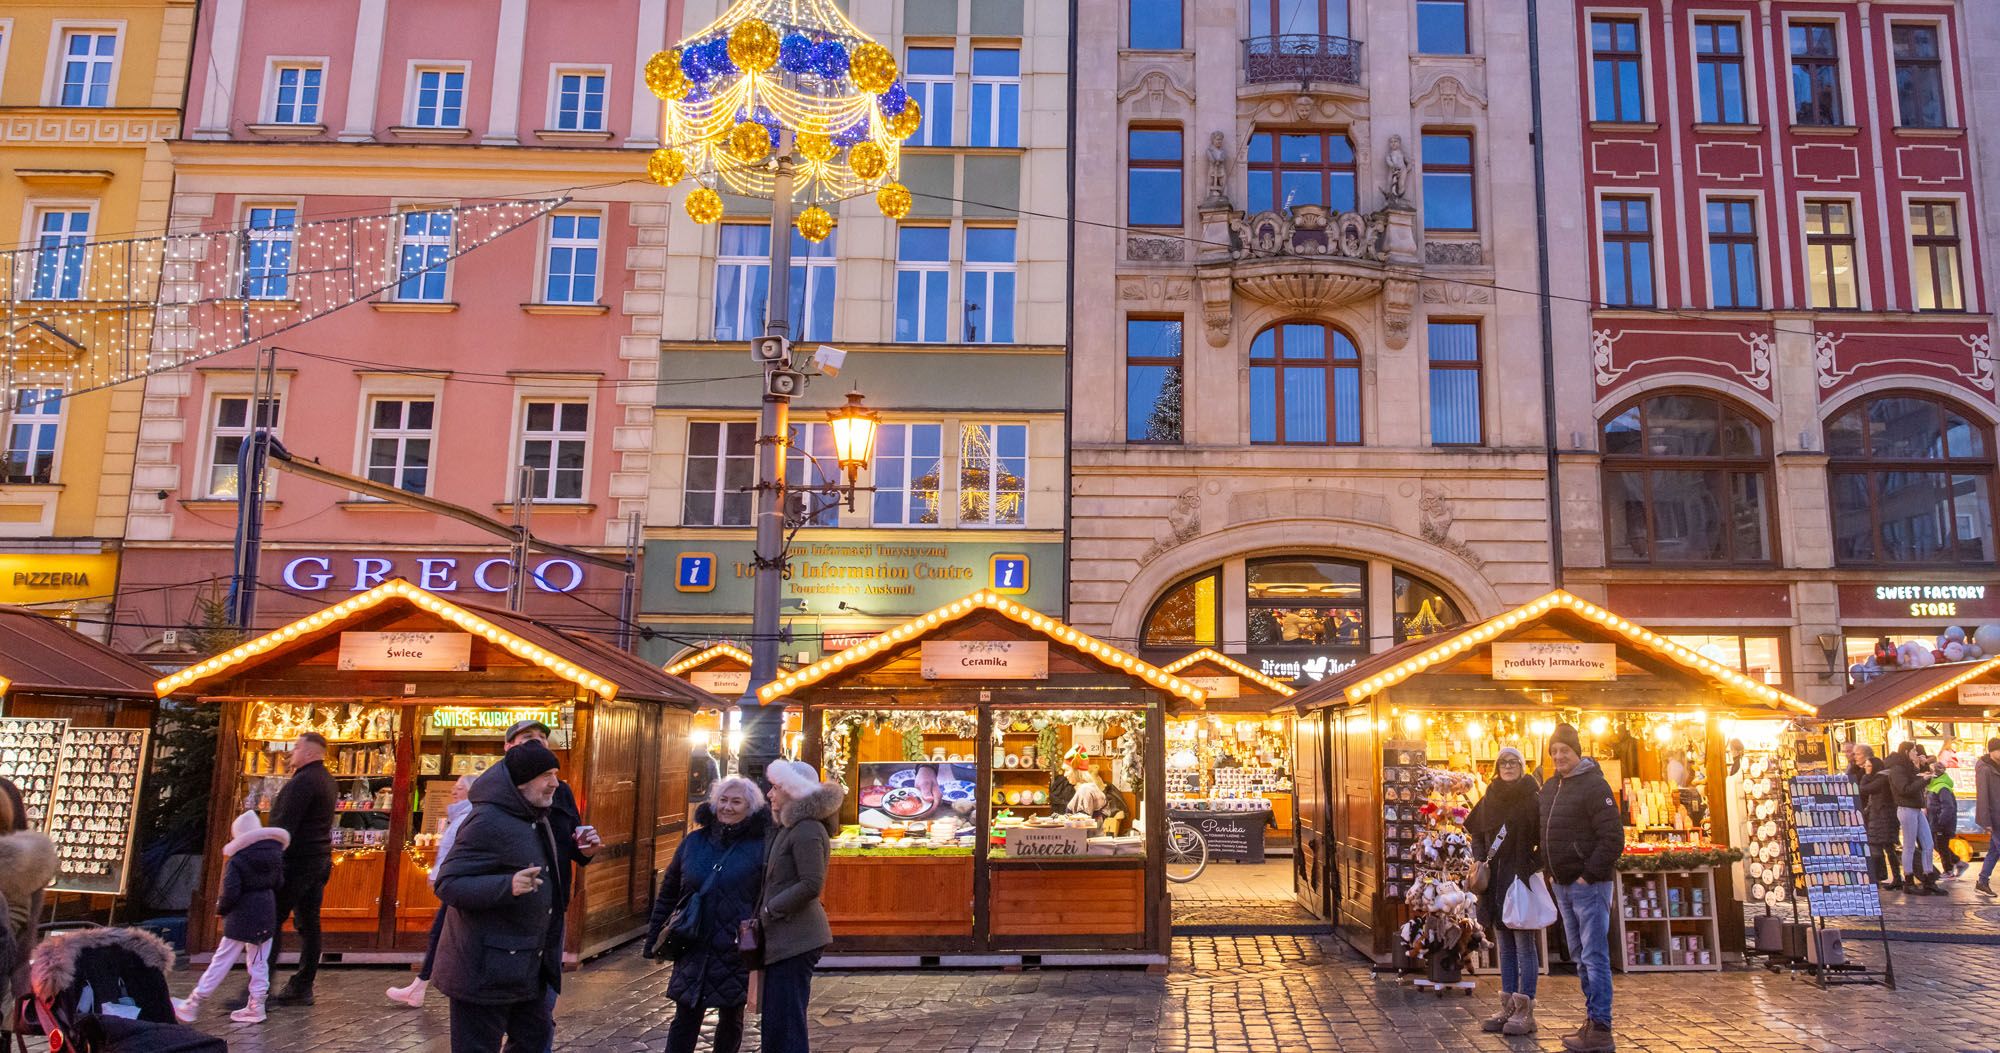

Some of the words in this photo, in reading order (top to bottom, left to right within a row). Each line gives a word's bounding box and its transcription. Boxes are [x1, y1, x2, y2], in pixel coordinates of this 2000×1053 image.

[811, 544, 873, 558] Informacji
[876, 544, 948, 559] Turystycznej
[282, 556, 585, 593] GRECO
[801, 562, 909, 579] Information
[913, 562, 974, 579] Centre
[13, 572, 89, 587] PIZZERIA
[1876, 586, 1922, 599] SWEET
[1923, 585, 1985, 599] FACTORY
[1910, 603, 1957, 616] STORE
[387, 647, 423, 659] Świece
[961, 657, 1008, 667] Ceramika
[1504, 658, 1546, 668] Produkty
[1549, 657, 1605, 668] Jarmarkowe
[433, 709, 477, 727] ŚWIECE
[479, 711, 513, 727] KUBKI
[1201, 819, 1246, 833] Panika
[1014, 839, 1079, 856] tareczki
